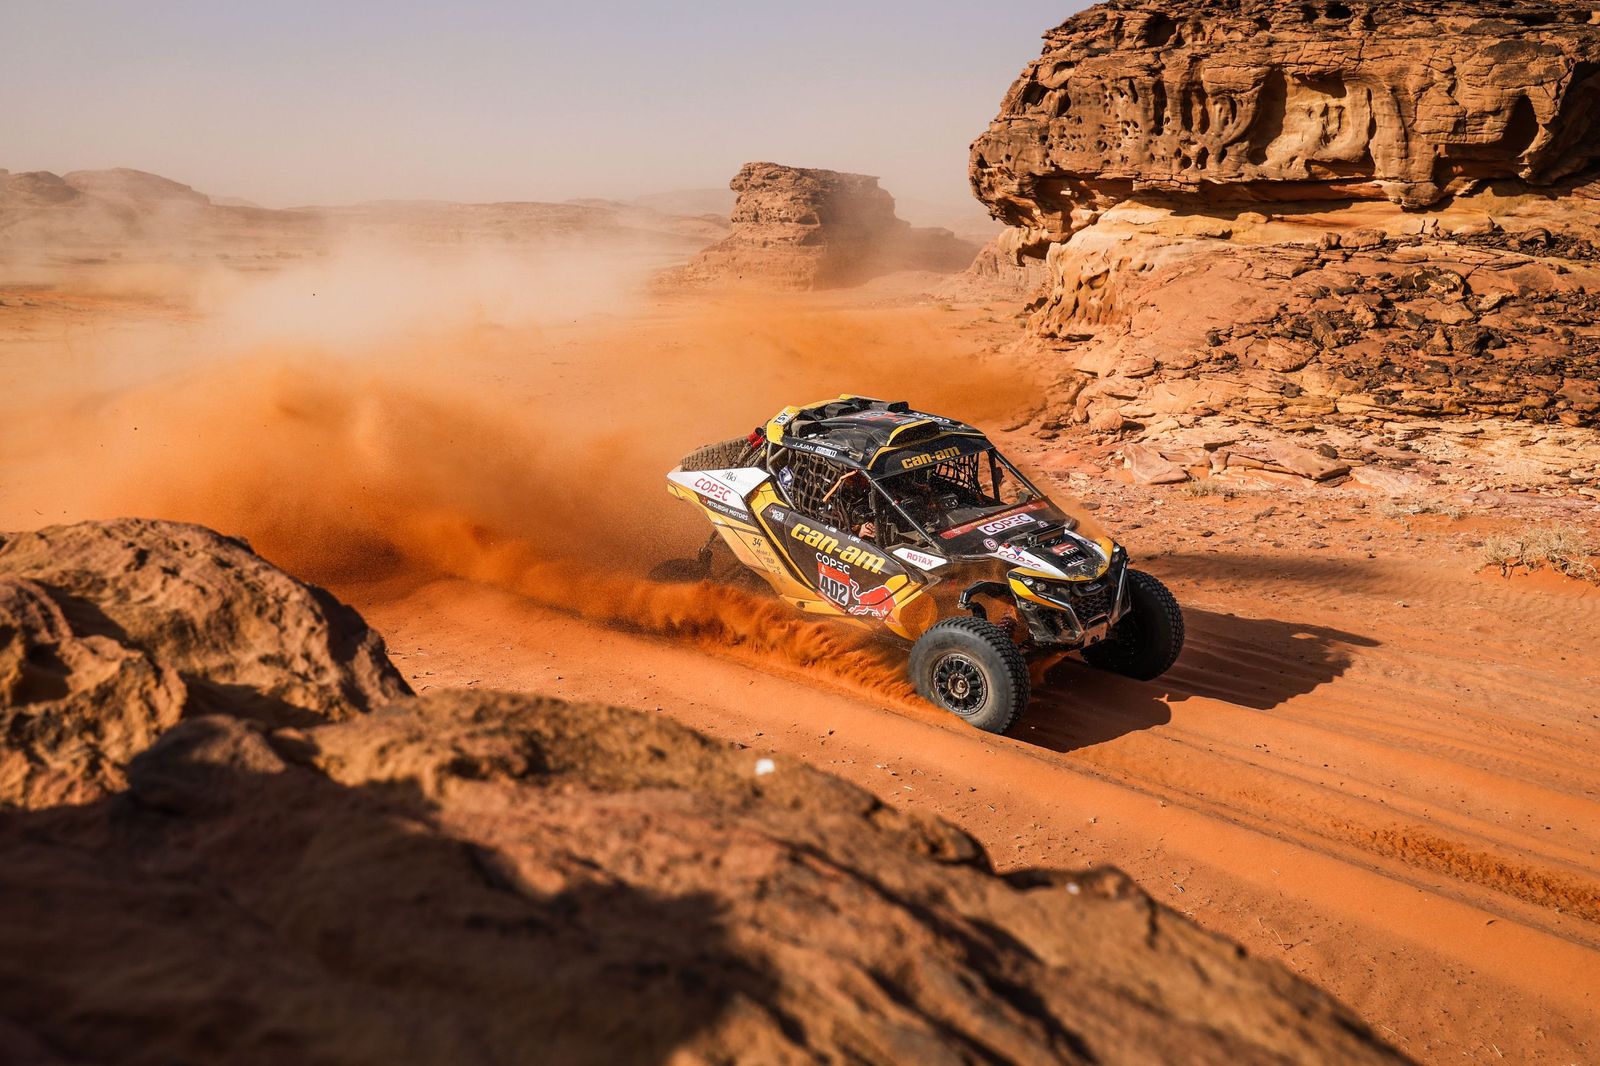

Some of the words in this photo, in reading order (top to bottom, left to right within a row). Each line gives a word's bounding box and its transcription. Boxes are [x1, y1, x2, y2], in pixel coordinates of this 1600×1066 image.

[901, 446, 961, 470] can-am
[694, 478, 731, 502] COPEC
[728, 509, 749, 521] MOTORS
[983, 514, 1031, 533] COPEC
[790, 522, 886, 575] can-am
[906, 552, 934, 567] ROTAX
[815, 552, 850, 575] COPEC
[820, 577, 848, 604] 402
